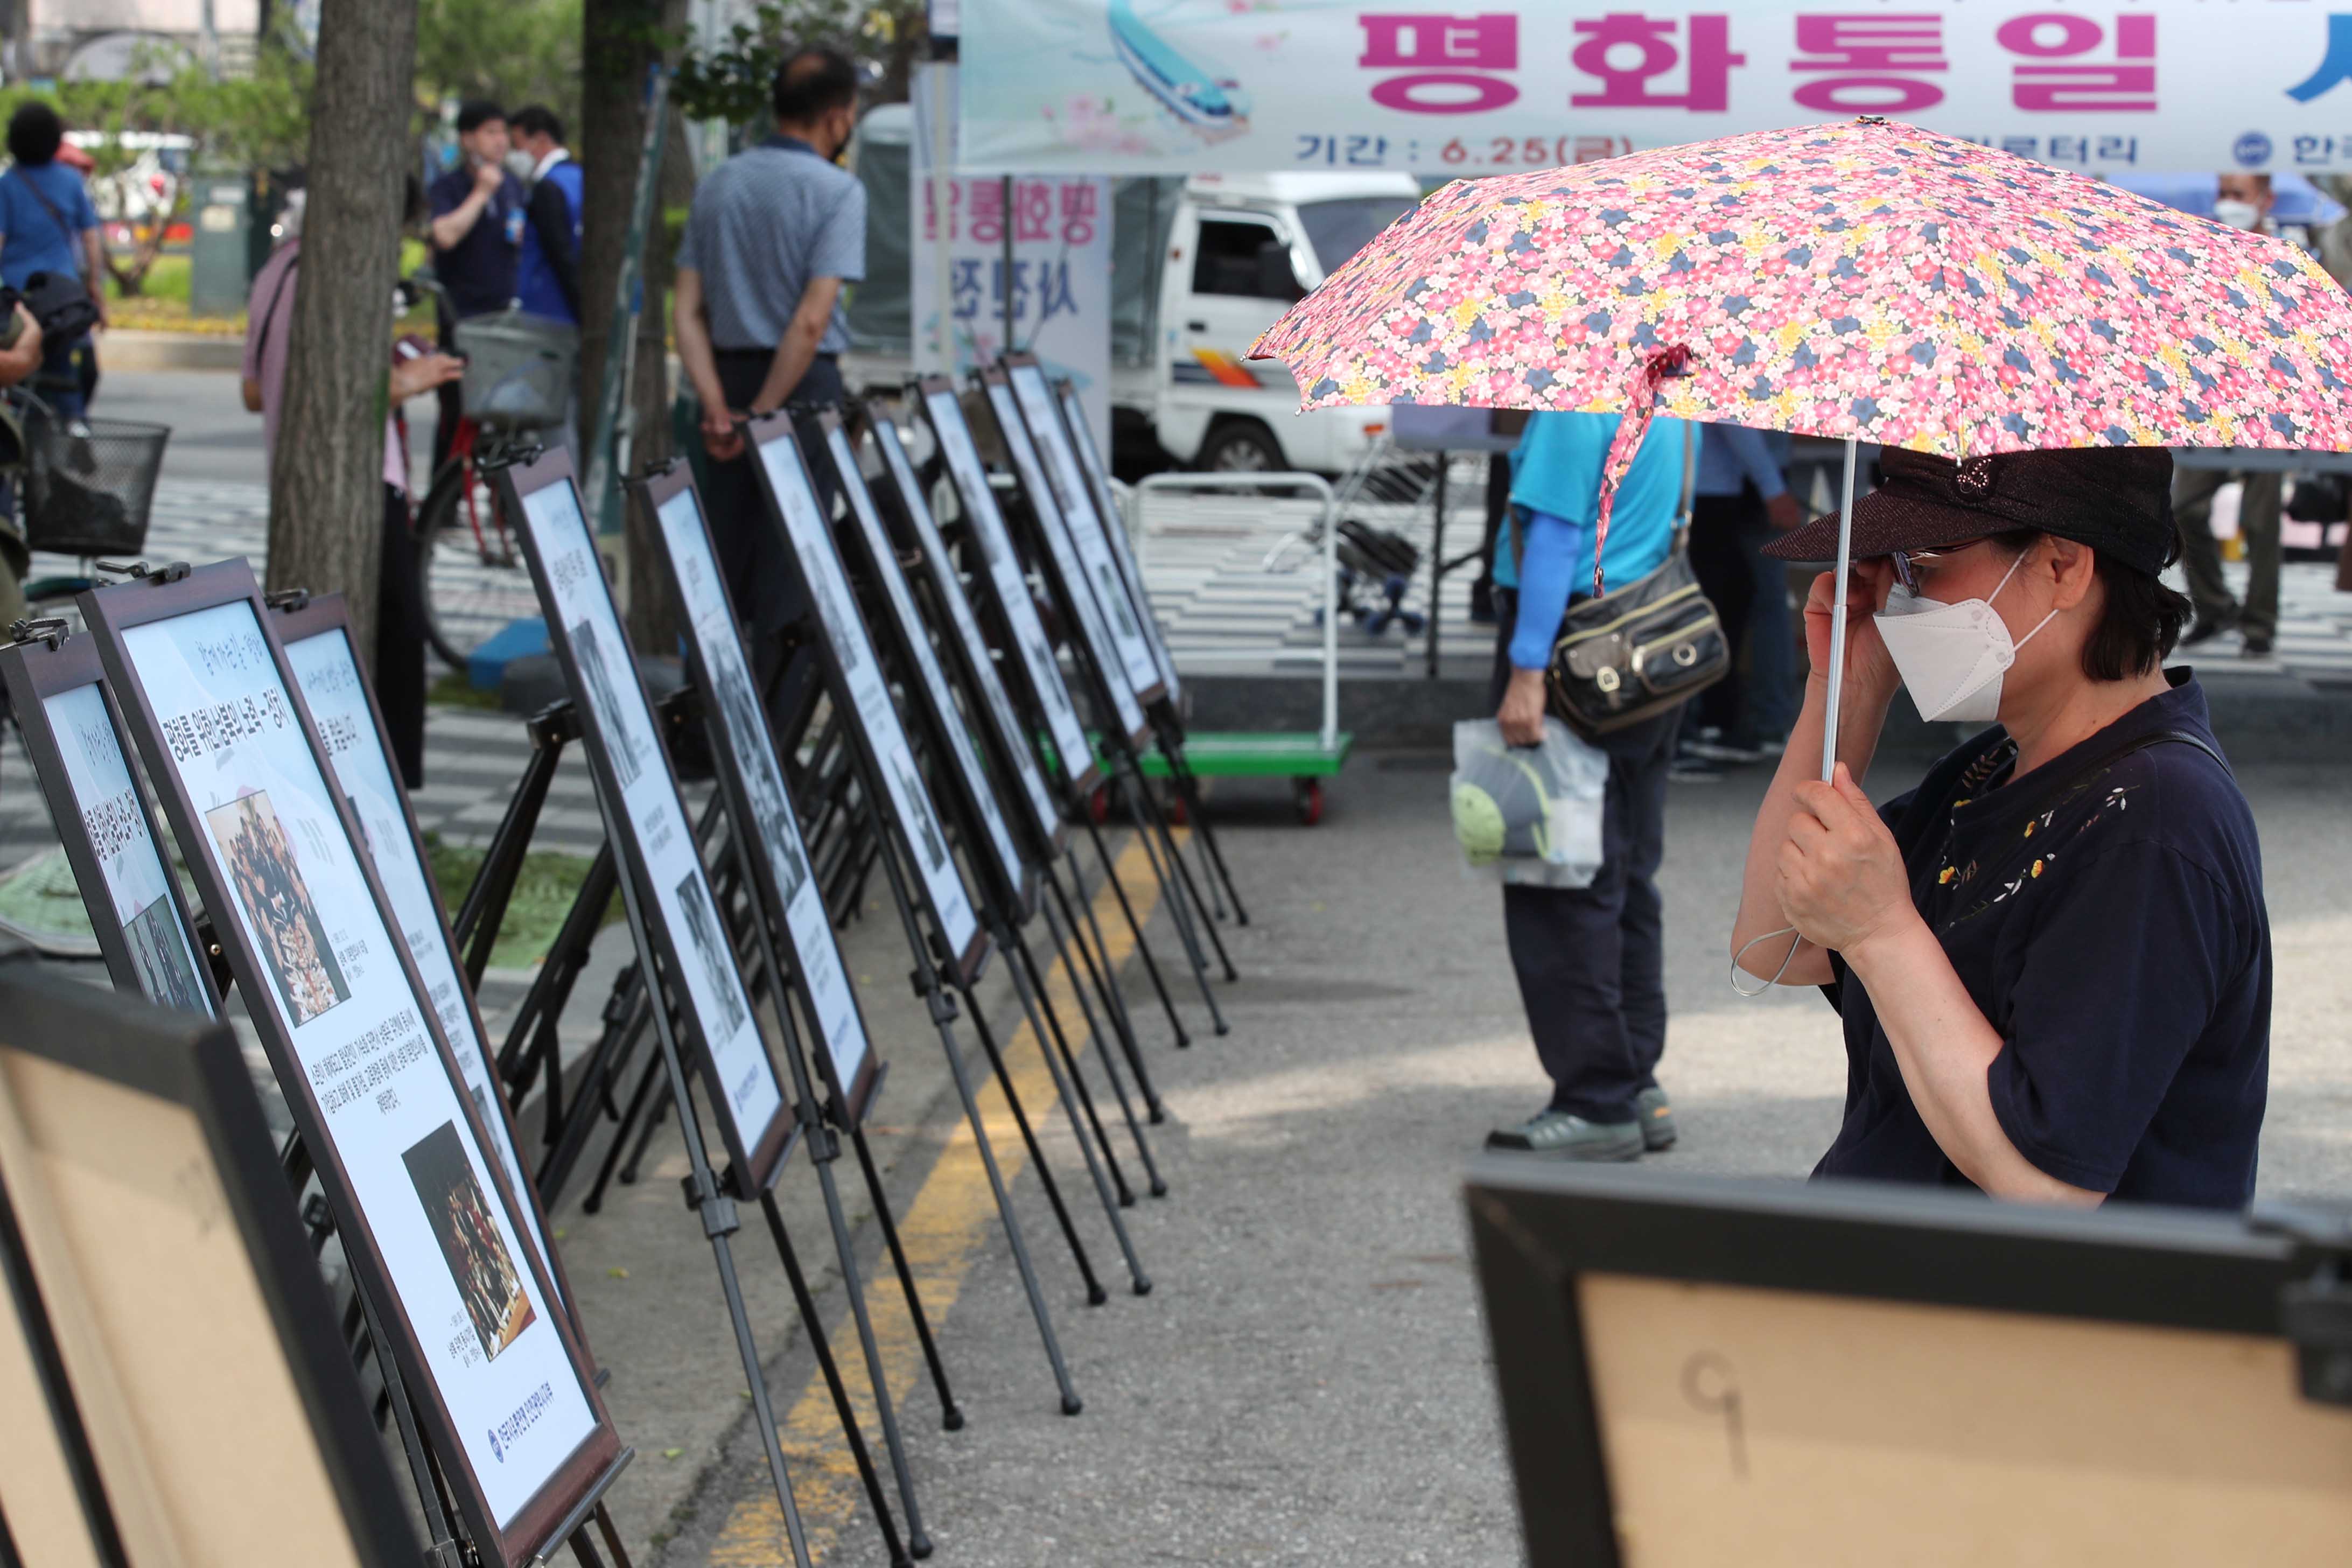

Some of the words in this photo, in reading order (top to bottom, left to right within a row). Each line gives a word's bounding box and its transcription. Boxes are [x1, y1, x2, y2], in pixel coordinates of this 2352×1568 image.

[1359, 13, 2157, 114] 평화통일
[1296, 136, 1386, 164] 기간
[2292, 135, 2352, 165] 한
[162, 715, 201, 762] 평화를
[191, 709, 220, 751] 위한
[209, 702, 247, 746] 남북의
[236, 695, 264, 734] 노력
[262, 688, 290, 729] 정치
[1677, 1348, 1751, 1485] 9
